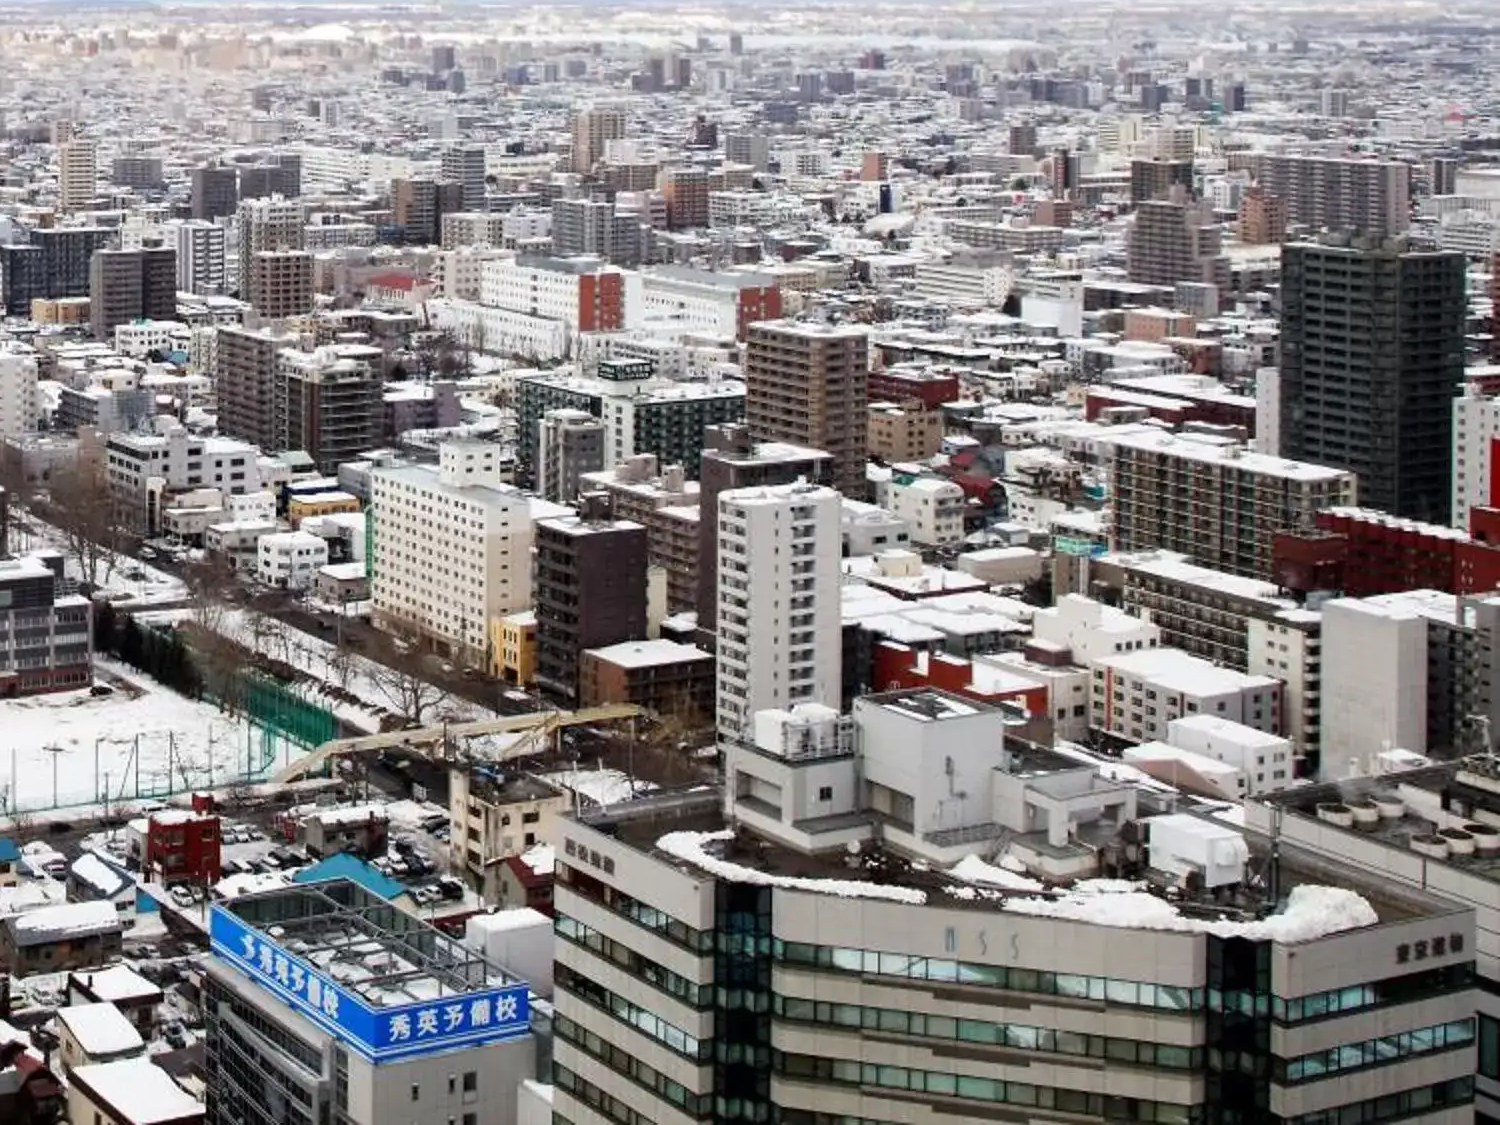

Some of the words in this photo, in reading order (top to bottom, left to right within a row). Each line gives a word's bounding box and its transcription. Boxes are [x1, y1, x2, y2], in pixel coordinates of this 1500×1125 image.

[389, 995, 517, 1042] 秀英予備校
